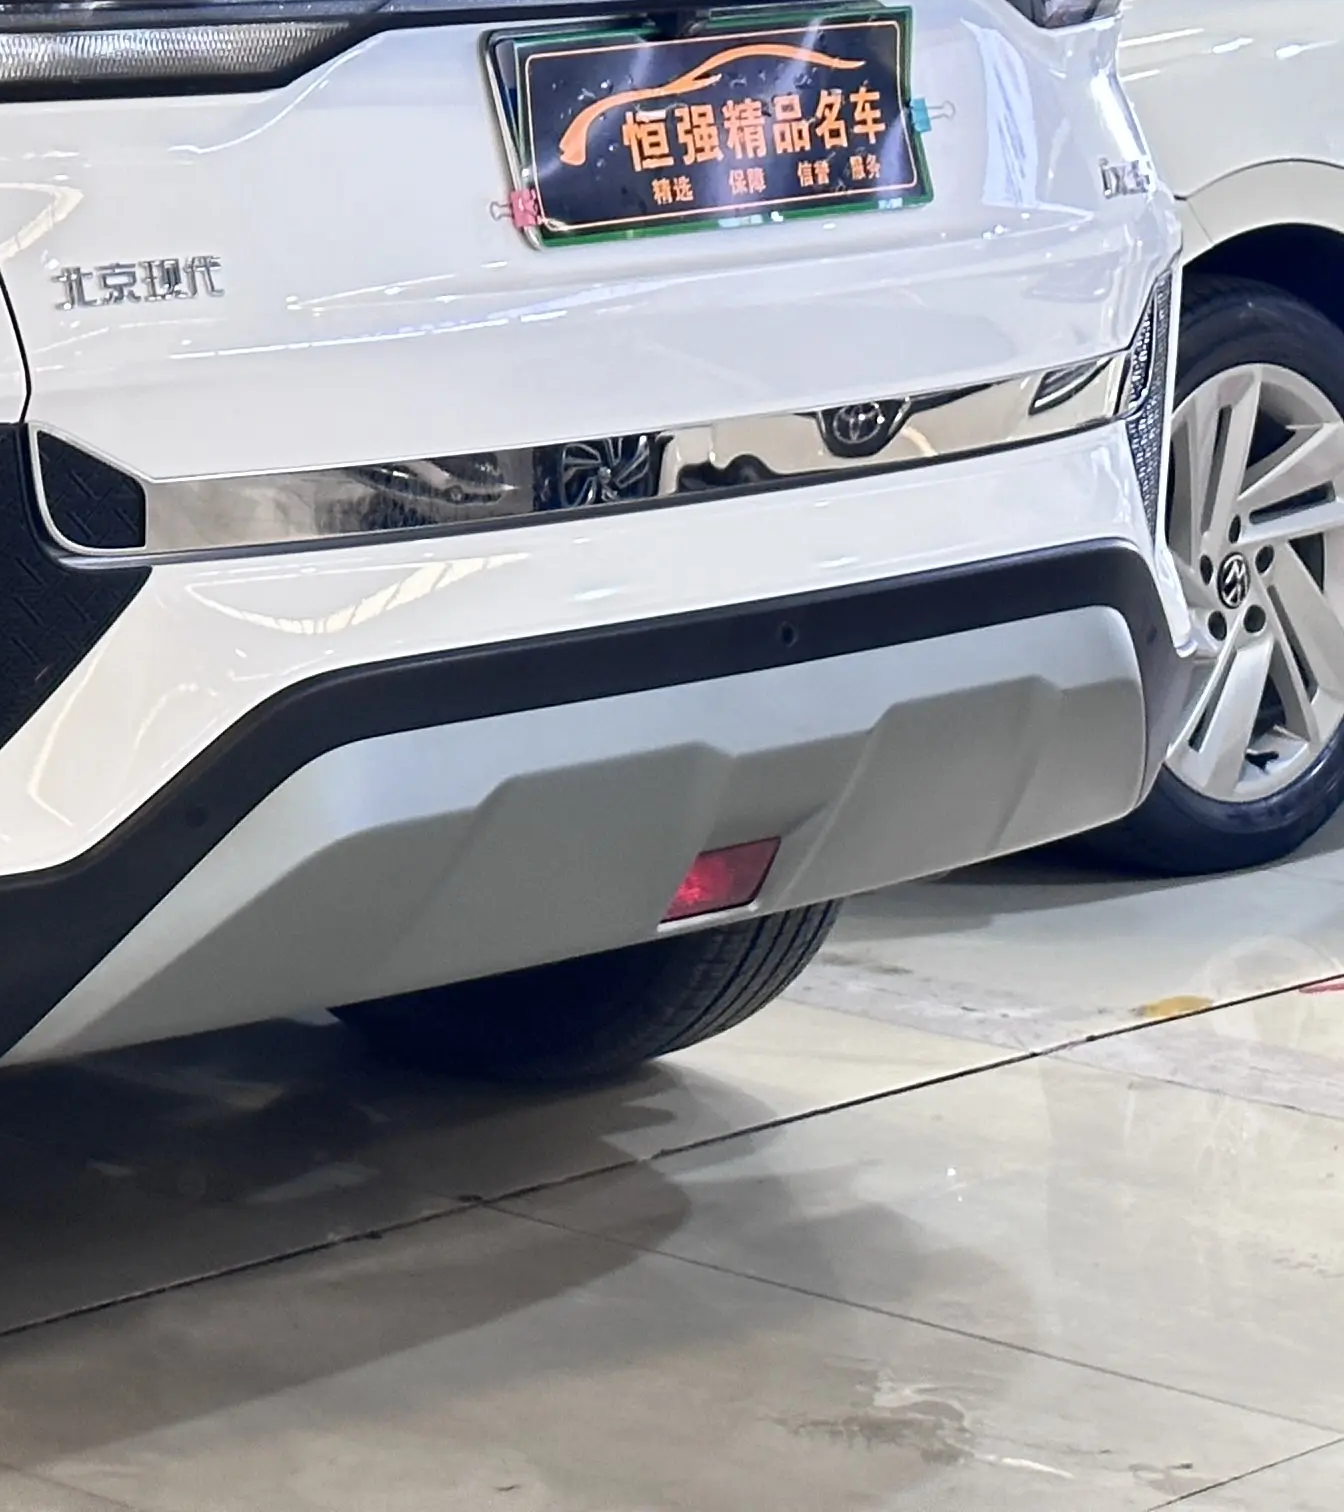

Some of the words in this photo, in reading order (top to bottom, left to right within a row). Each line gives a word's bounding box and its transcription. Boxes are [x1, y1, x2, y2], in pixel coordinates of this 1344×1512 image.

[621, 84, 887, 173] 恒强精品名车
[652, 175, 695, 205] 精选
[729, 166, 767, 198] 保障
[50, 255, 226, 311] 北京现代
